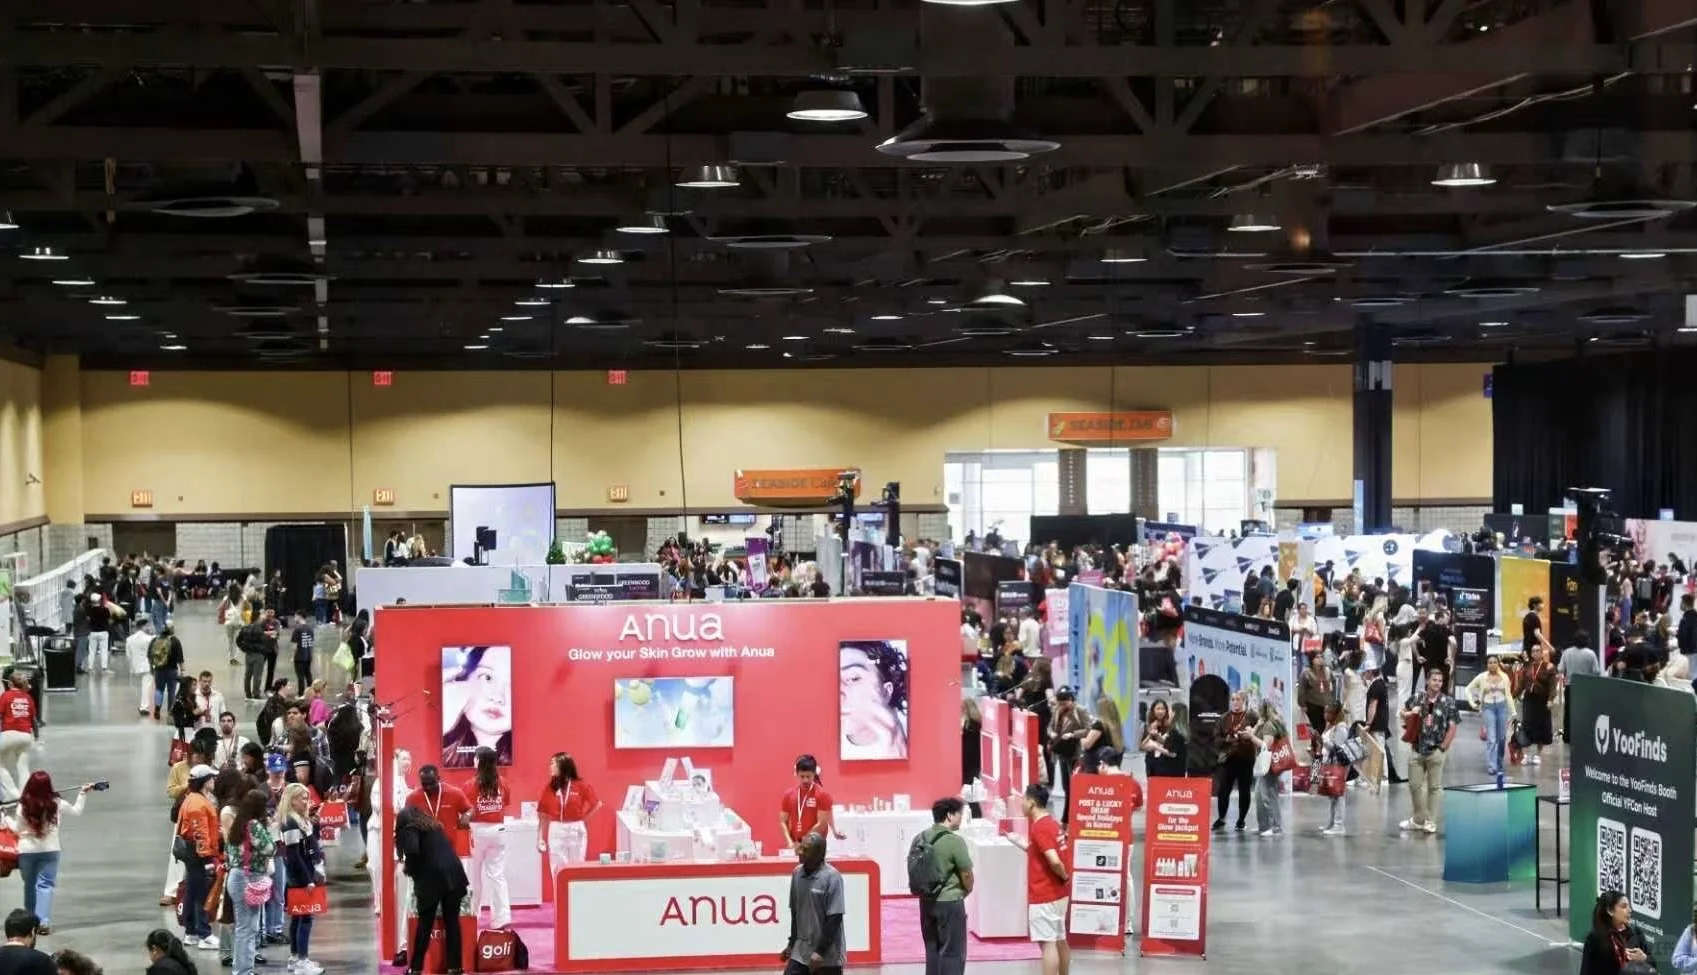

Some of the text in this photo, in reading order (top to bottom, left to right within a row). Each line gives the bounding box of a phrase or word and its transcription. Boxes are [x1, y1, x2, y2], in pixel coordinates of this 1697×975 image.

[752, 478, 806, 489] SEASIDE
[377, 490, 393, 502] EXIT
[619, 612, 723, 641] Anua
[568, 645, 774, 662] Glow your Skin Grow with Anua
[1613, 727, 1668, 763] YooFinds
[1584, 763, 1677, 800] Welcome to the YooFinds Booth
[1087, 786, 1114, 796] Anua
[1165, 789, 1193, 799] Anua
[1602, 791, 1623, 807] Official
[1643, 801, 1657, 817] Host
[292, 903, 321, 913] Anua
[660, 893, 779, 926] Anua
[482, 942, 513, 959] goli
